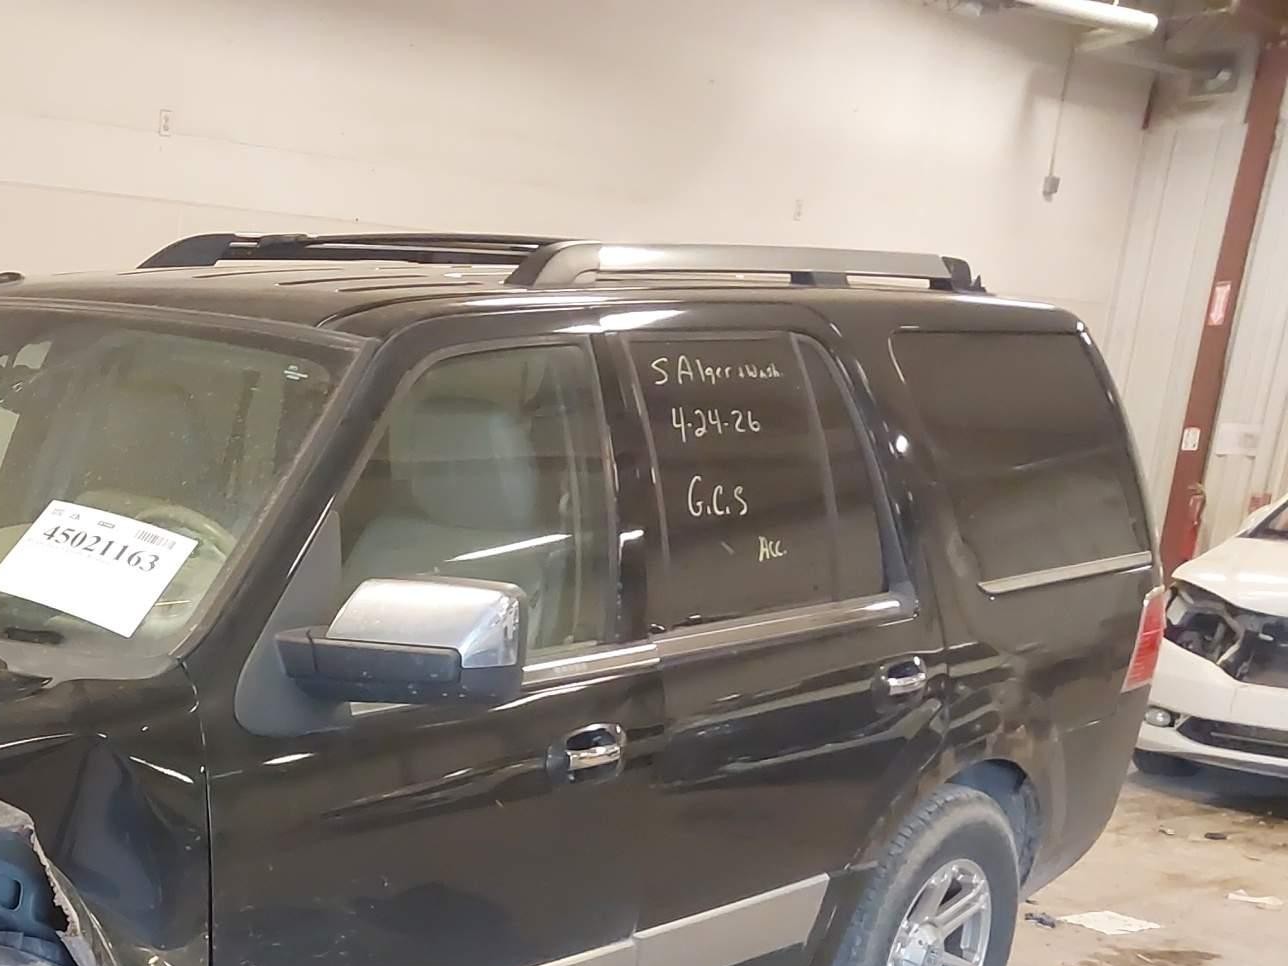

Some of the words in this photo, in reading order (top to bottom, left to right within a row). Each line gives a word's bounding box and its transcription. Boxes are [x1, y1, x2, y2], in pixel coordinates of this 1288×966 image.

[650, 357, 669, 385] S
[671, 407, 762, 443] 4-24-26
[43, 525, 161, 573] 45021163
